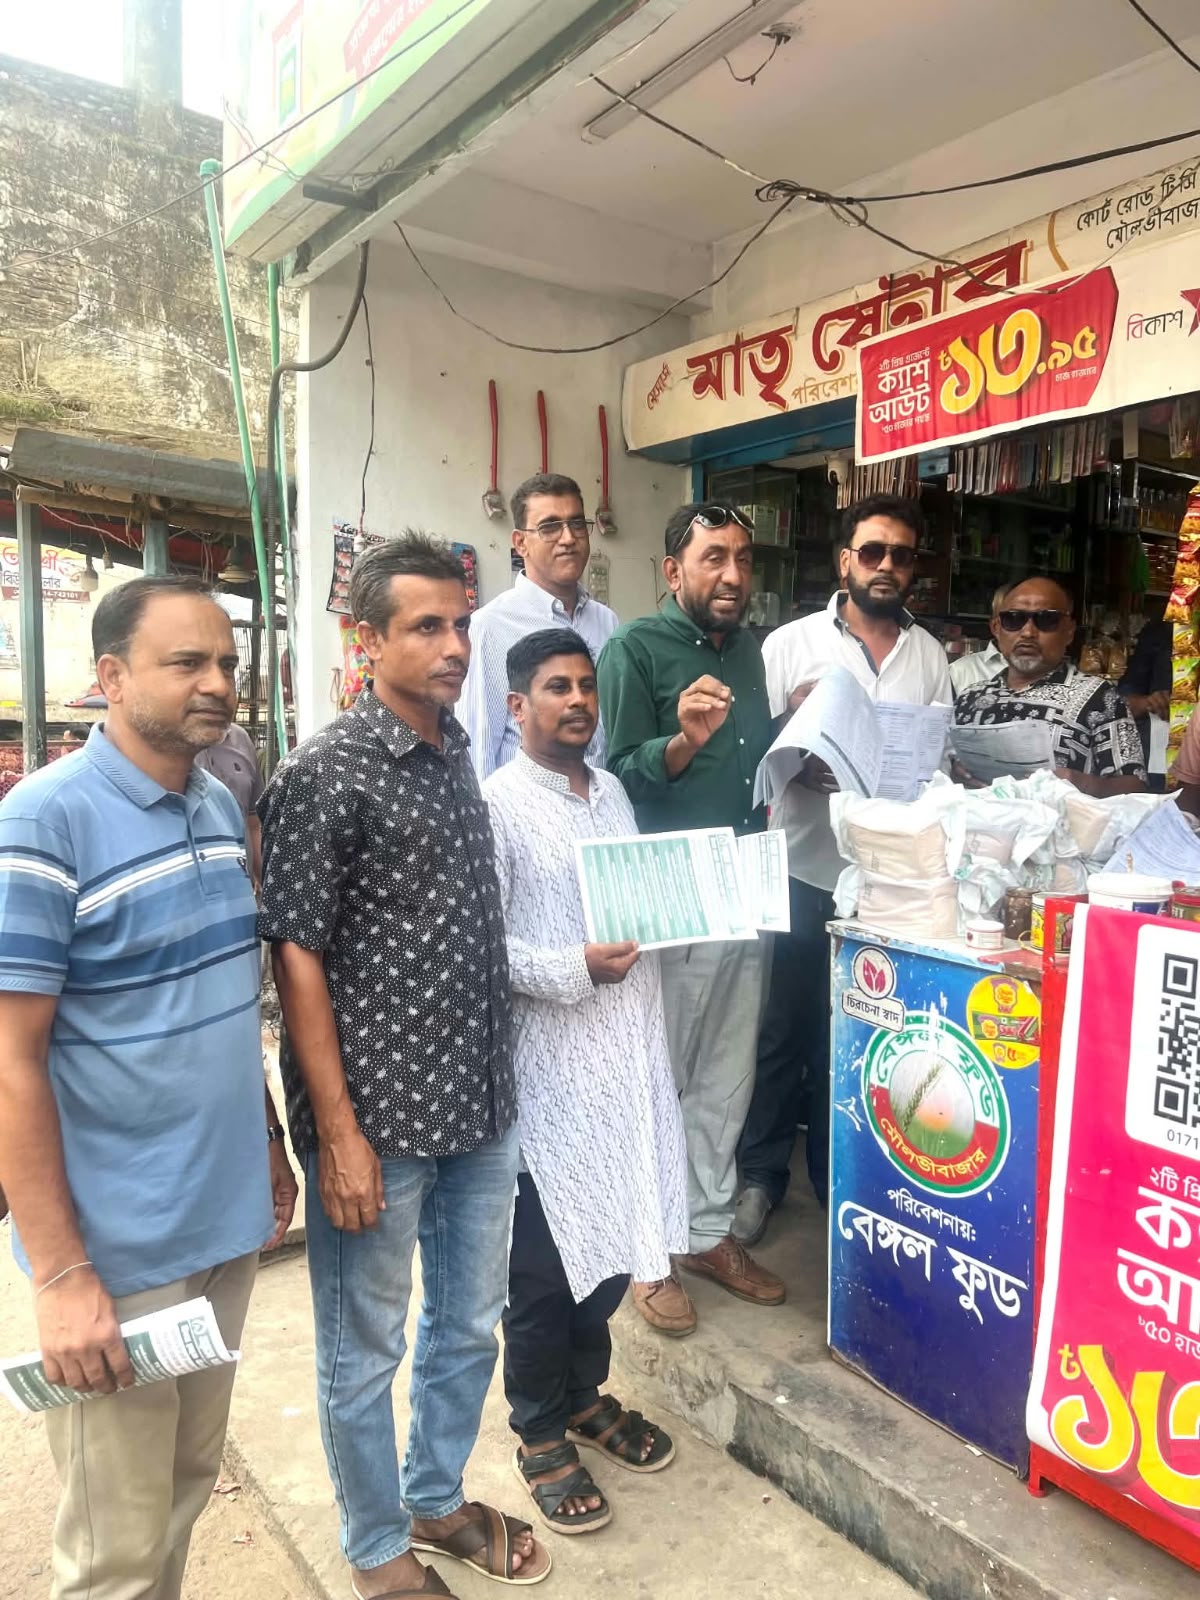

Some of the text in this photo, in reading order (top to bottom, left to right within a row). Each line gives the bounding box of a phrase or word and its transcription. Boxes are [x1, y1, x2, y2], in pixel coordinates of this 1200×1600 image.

[1077, 198, 1112, 231] কোর্ট
[1117, 186, 1155, 216] রোড
[1126, 309, 1184, 342] বিকাশ
[687, 325, 793, 411] মাতৃ
[877, 358, 931, 394] ক্যাশ
[791, 373, 857, 404] পরিবেশ
[868, 383, 931, 423] আউট
[1167, 1129, 1200, 1151] 0171
[838, 1201, 1029, 1325] বেঙ্গল ফুড
